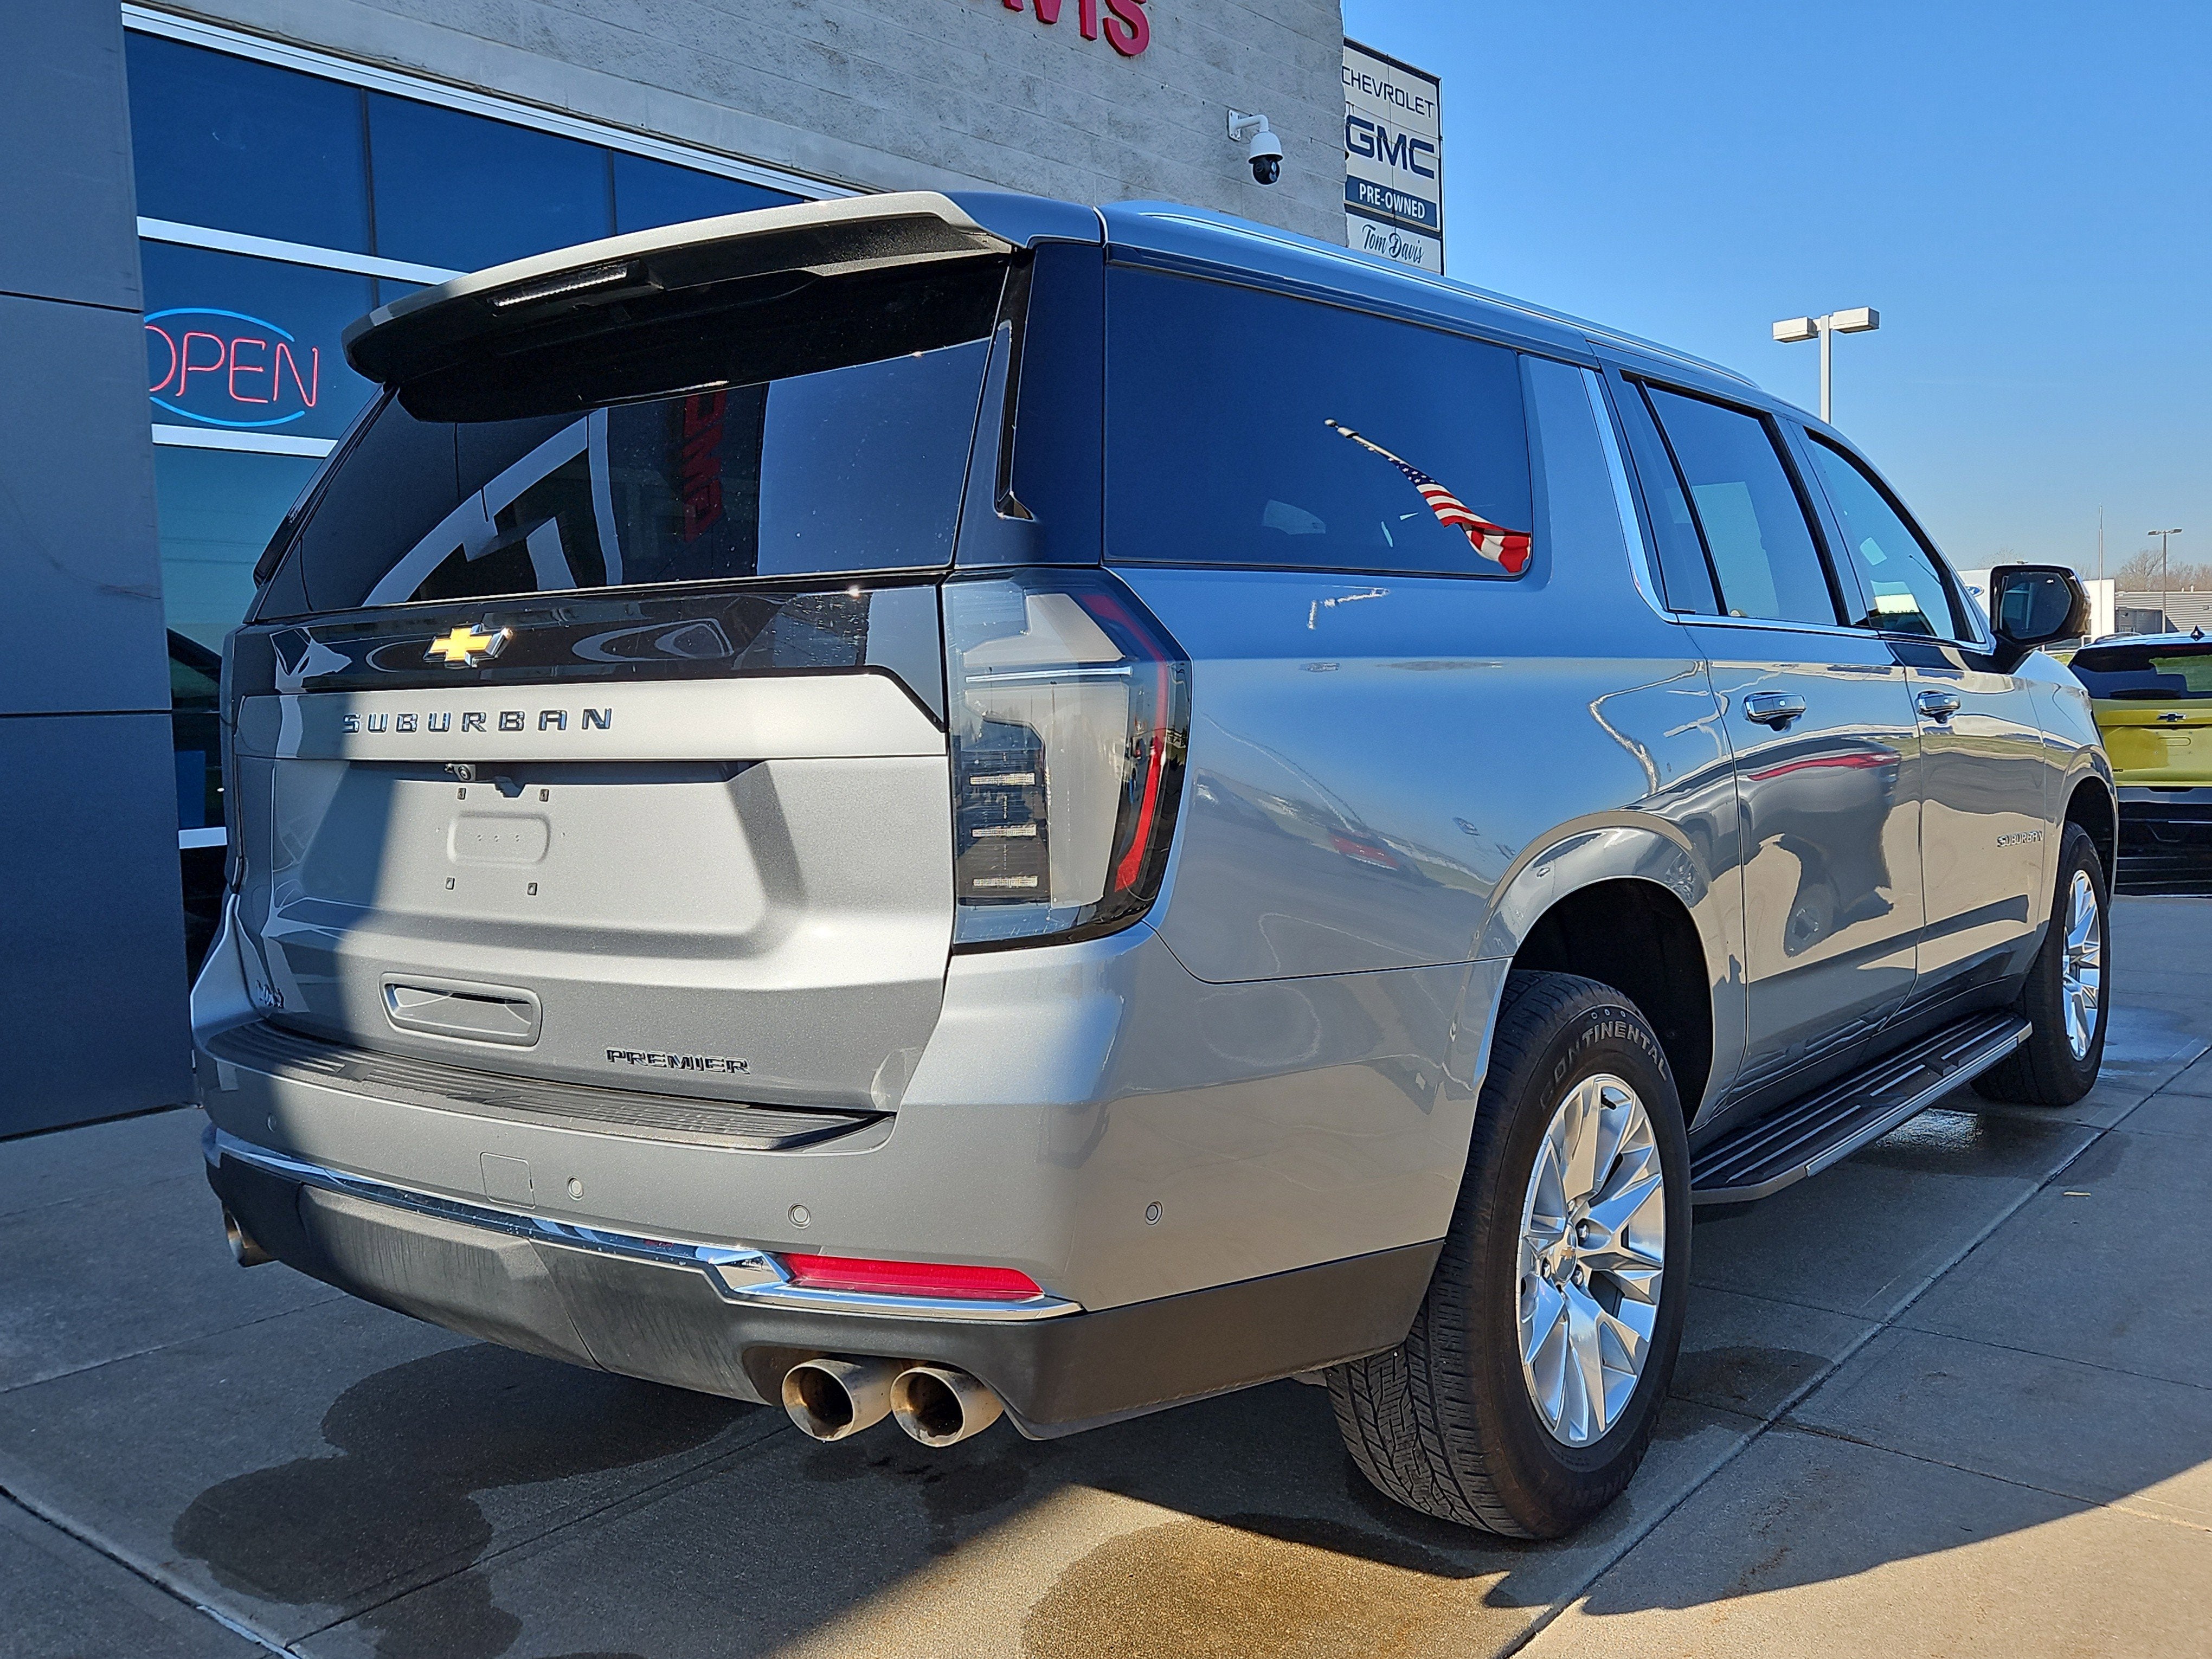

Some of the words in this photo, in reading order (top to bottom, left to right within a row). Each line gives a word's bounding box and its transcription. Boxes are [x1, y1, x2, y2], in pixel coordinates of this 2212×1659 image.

[1341, 66, 1434, 118] CHEVROLET
[1346, 114, 1435, 179] GMC
[1359, 183, 1425, 219] PRE-OWNED
[1362, 224, 1388, 255] Tom
[1388, 232, 1424, 264] Davis
[342, 708, 612, 734] SUBURBAN
[1997, 830, 2043, 847] SUBURBAN
[606, 1048, 750, 1075] PREMIER
